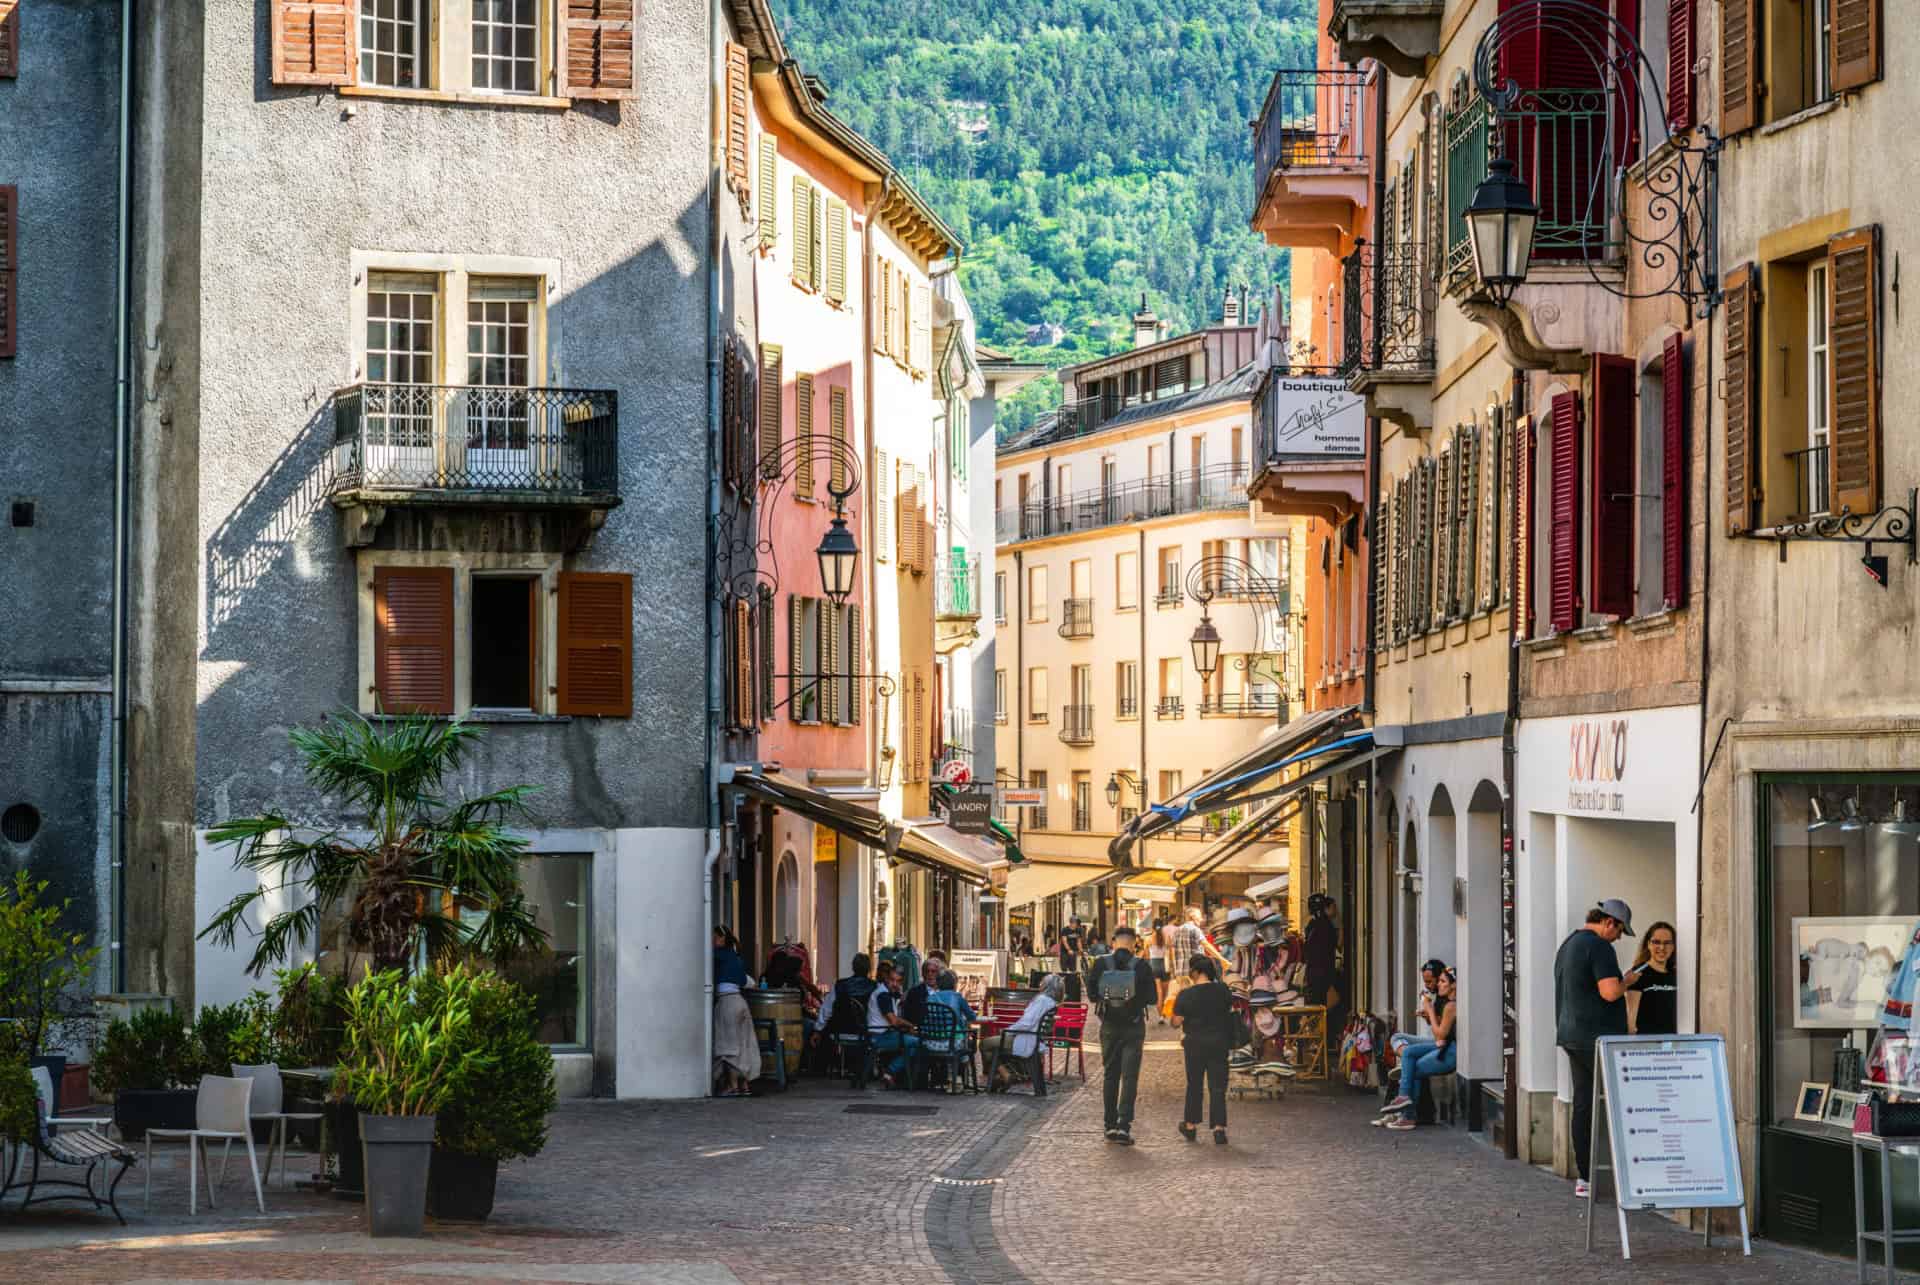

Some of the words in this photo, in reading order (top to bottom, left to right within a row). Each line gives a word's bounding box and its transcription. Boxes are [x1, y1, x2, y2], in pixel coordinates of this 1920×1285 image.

[1282, 381, 1351, 394] boutiqu
[1314, 434, 1361, 442] hommes
[1325, 444, 1361, 452] dames
[952, 802, 989, 812] LANDRY
